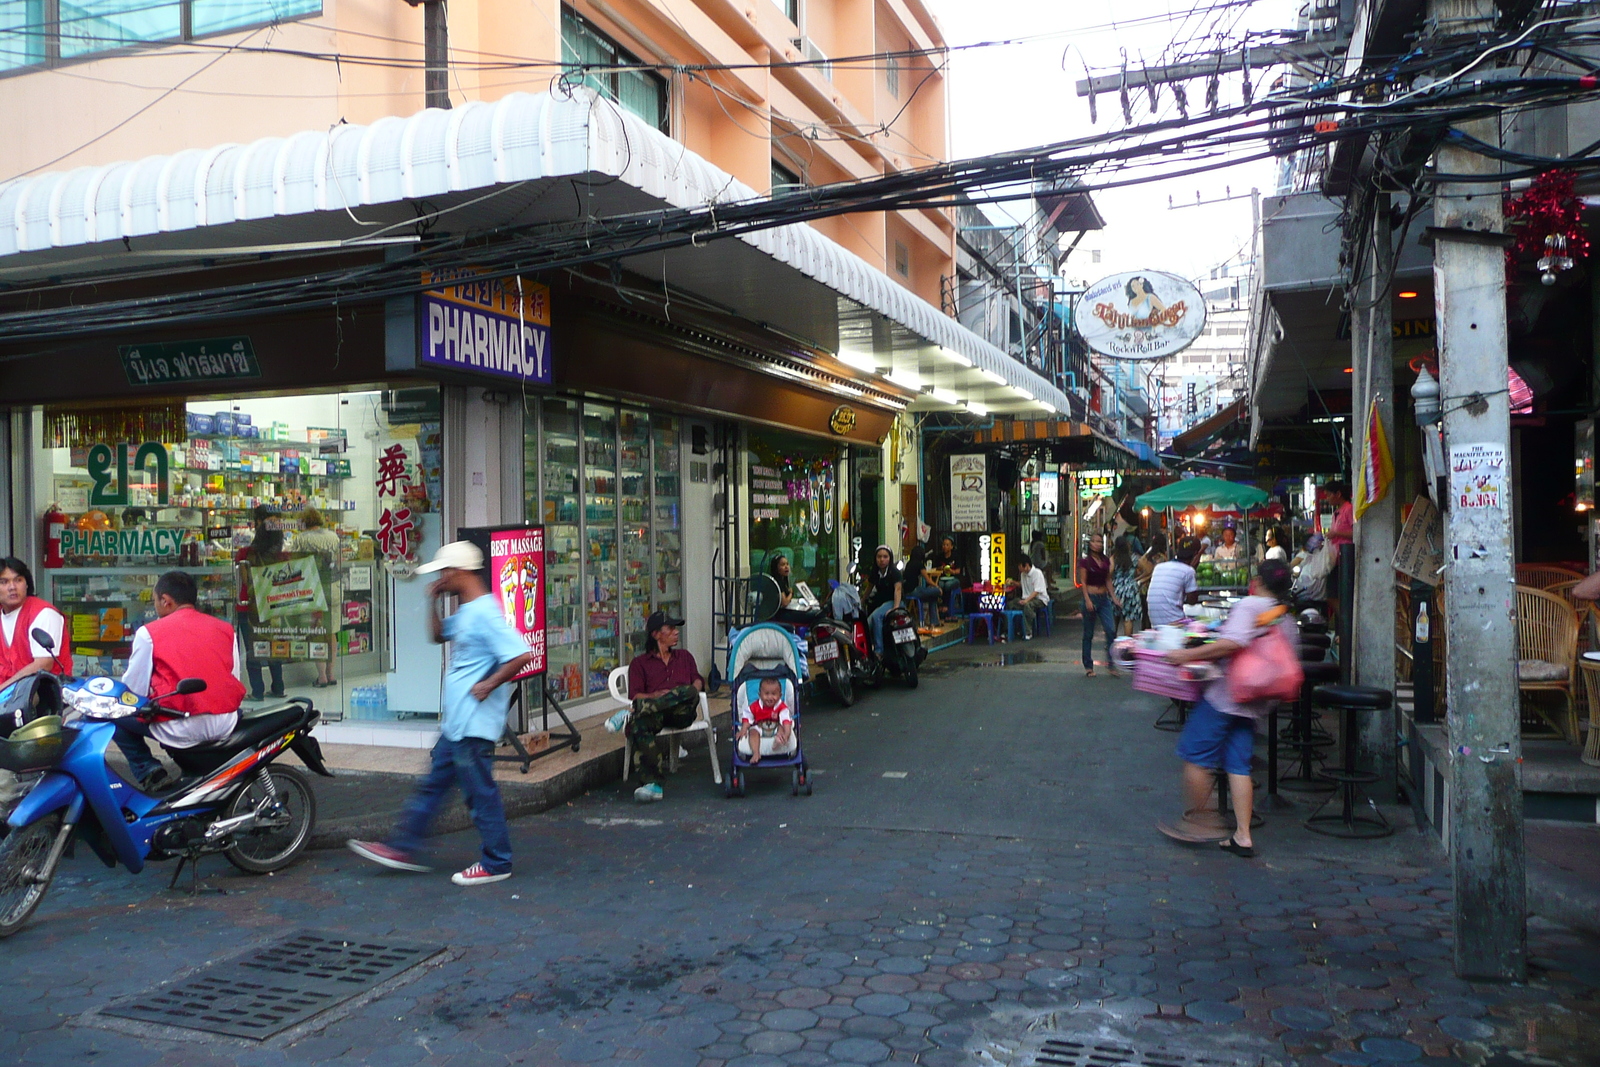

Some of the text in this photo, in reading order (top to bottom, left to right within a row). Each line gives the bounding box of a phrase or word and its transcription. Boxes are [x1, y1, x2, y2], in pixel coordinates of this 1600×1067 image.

[429, 302, 546, 378] PHARMACY
[1392, 319, 1437, 337] SIN
[130, 341, 249, 381] บี.เจ.ฟาร์มาซี
[87, 442, 169, 506] ยา
[266, 503, 304, 513] WELCOME
[211, 529, 228, 537] OPEN
[953, 521, 986, 532] OPEN
[61, 529, 186, 556] PHARMACY
[490, 536, 543, 557] BEST MASSAGE
[993, 536, 1003, 584] CALLS
